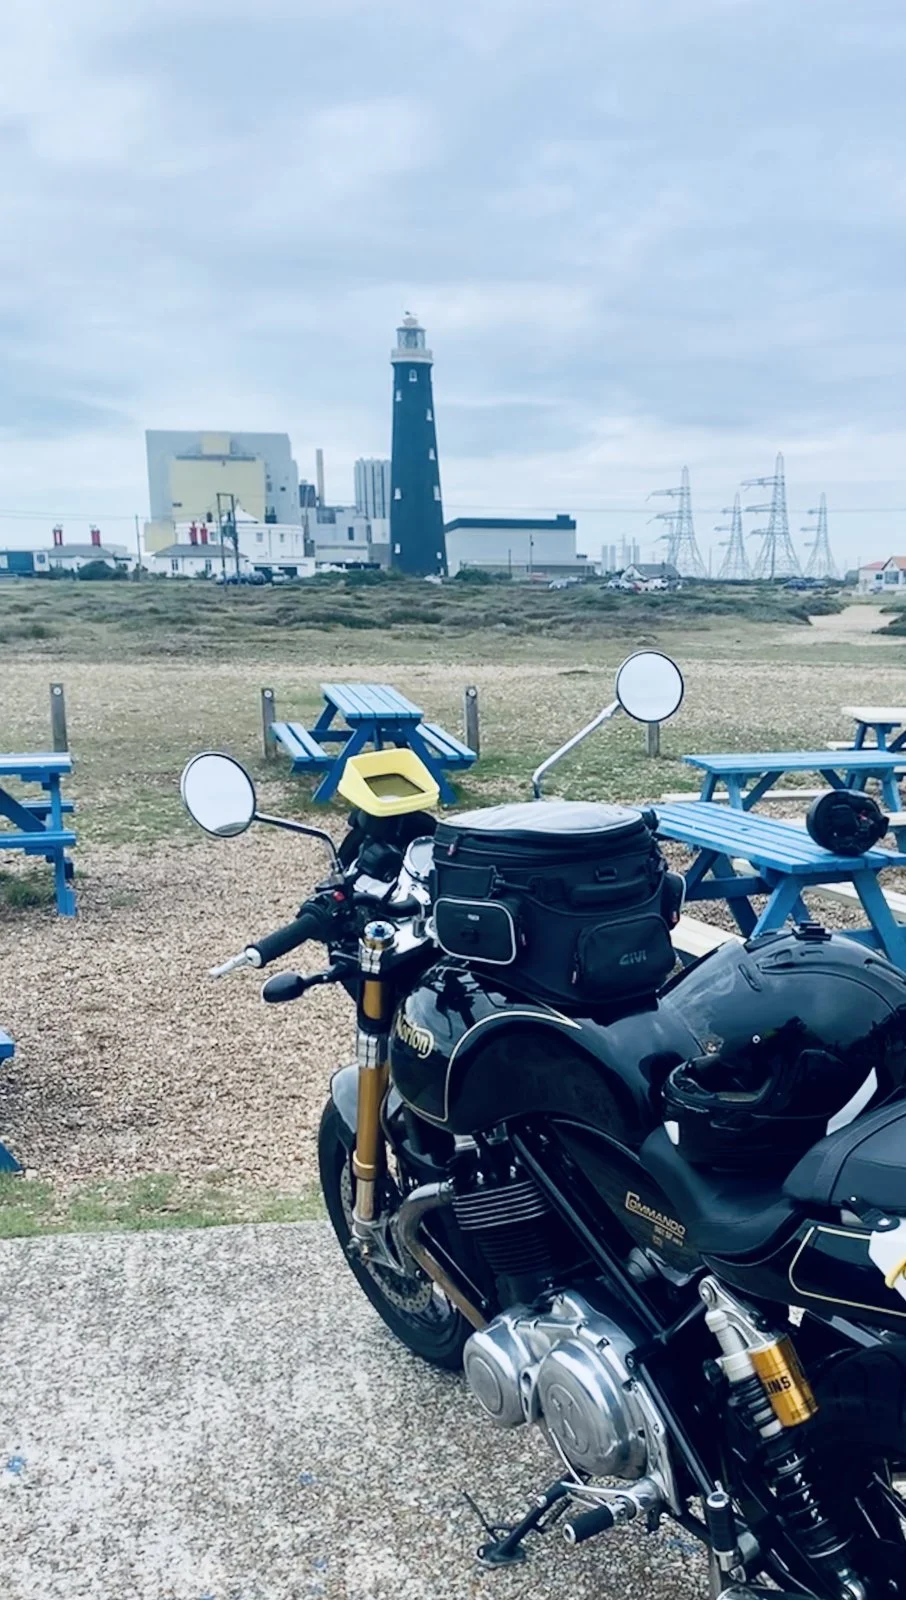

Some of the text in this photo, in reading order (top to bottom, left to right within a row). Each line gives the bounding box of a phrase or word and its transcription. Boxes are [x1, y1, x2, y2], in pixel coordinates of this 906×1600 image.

[619, 949, 647, 965] GIVI
[625, 1190, 686, 1237] COMMANDO
[766, 1375, 792, 1394] INS
